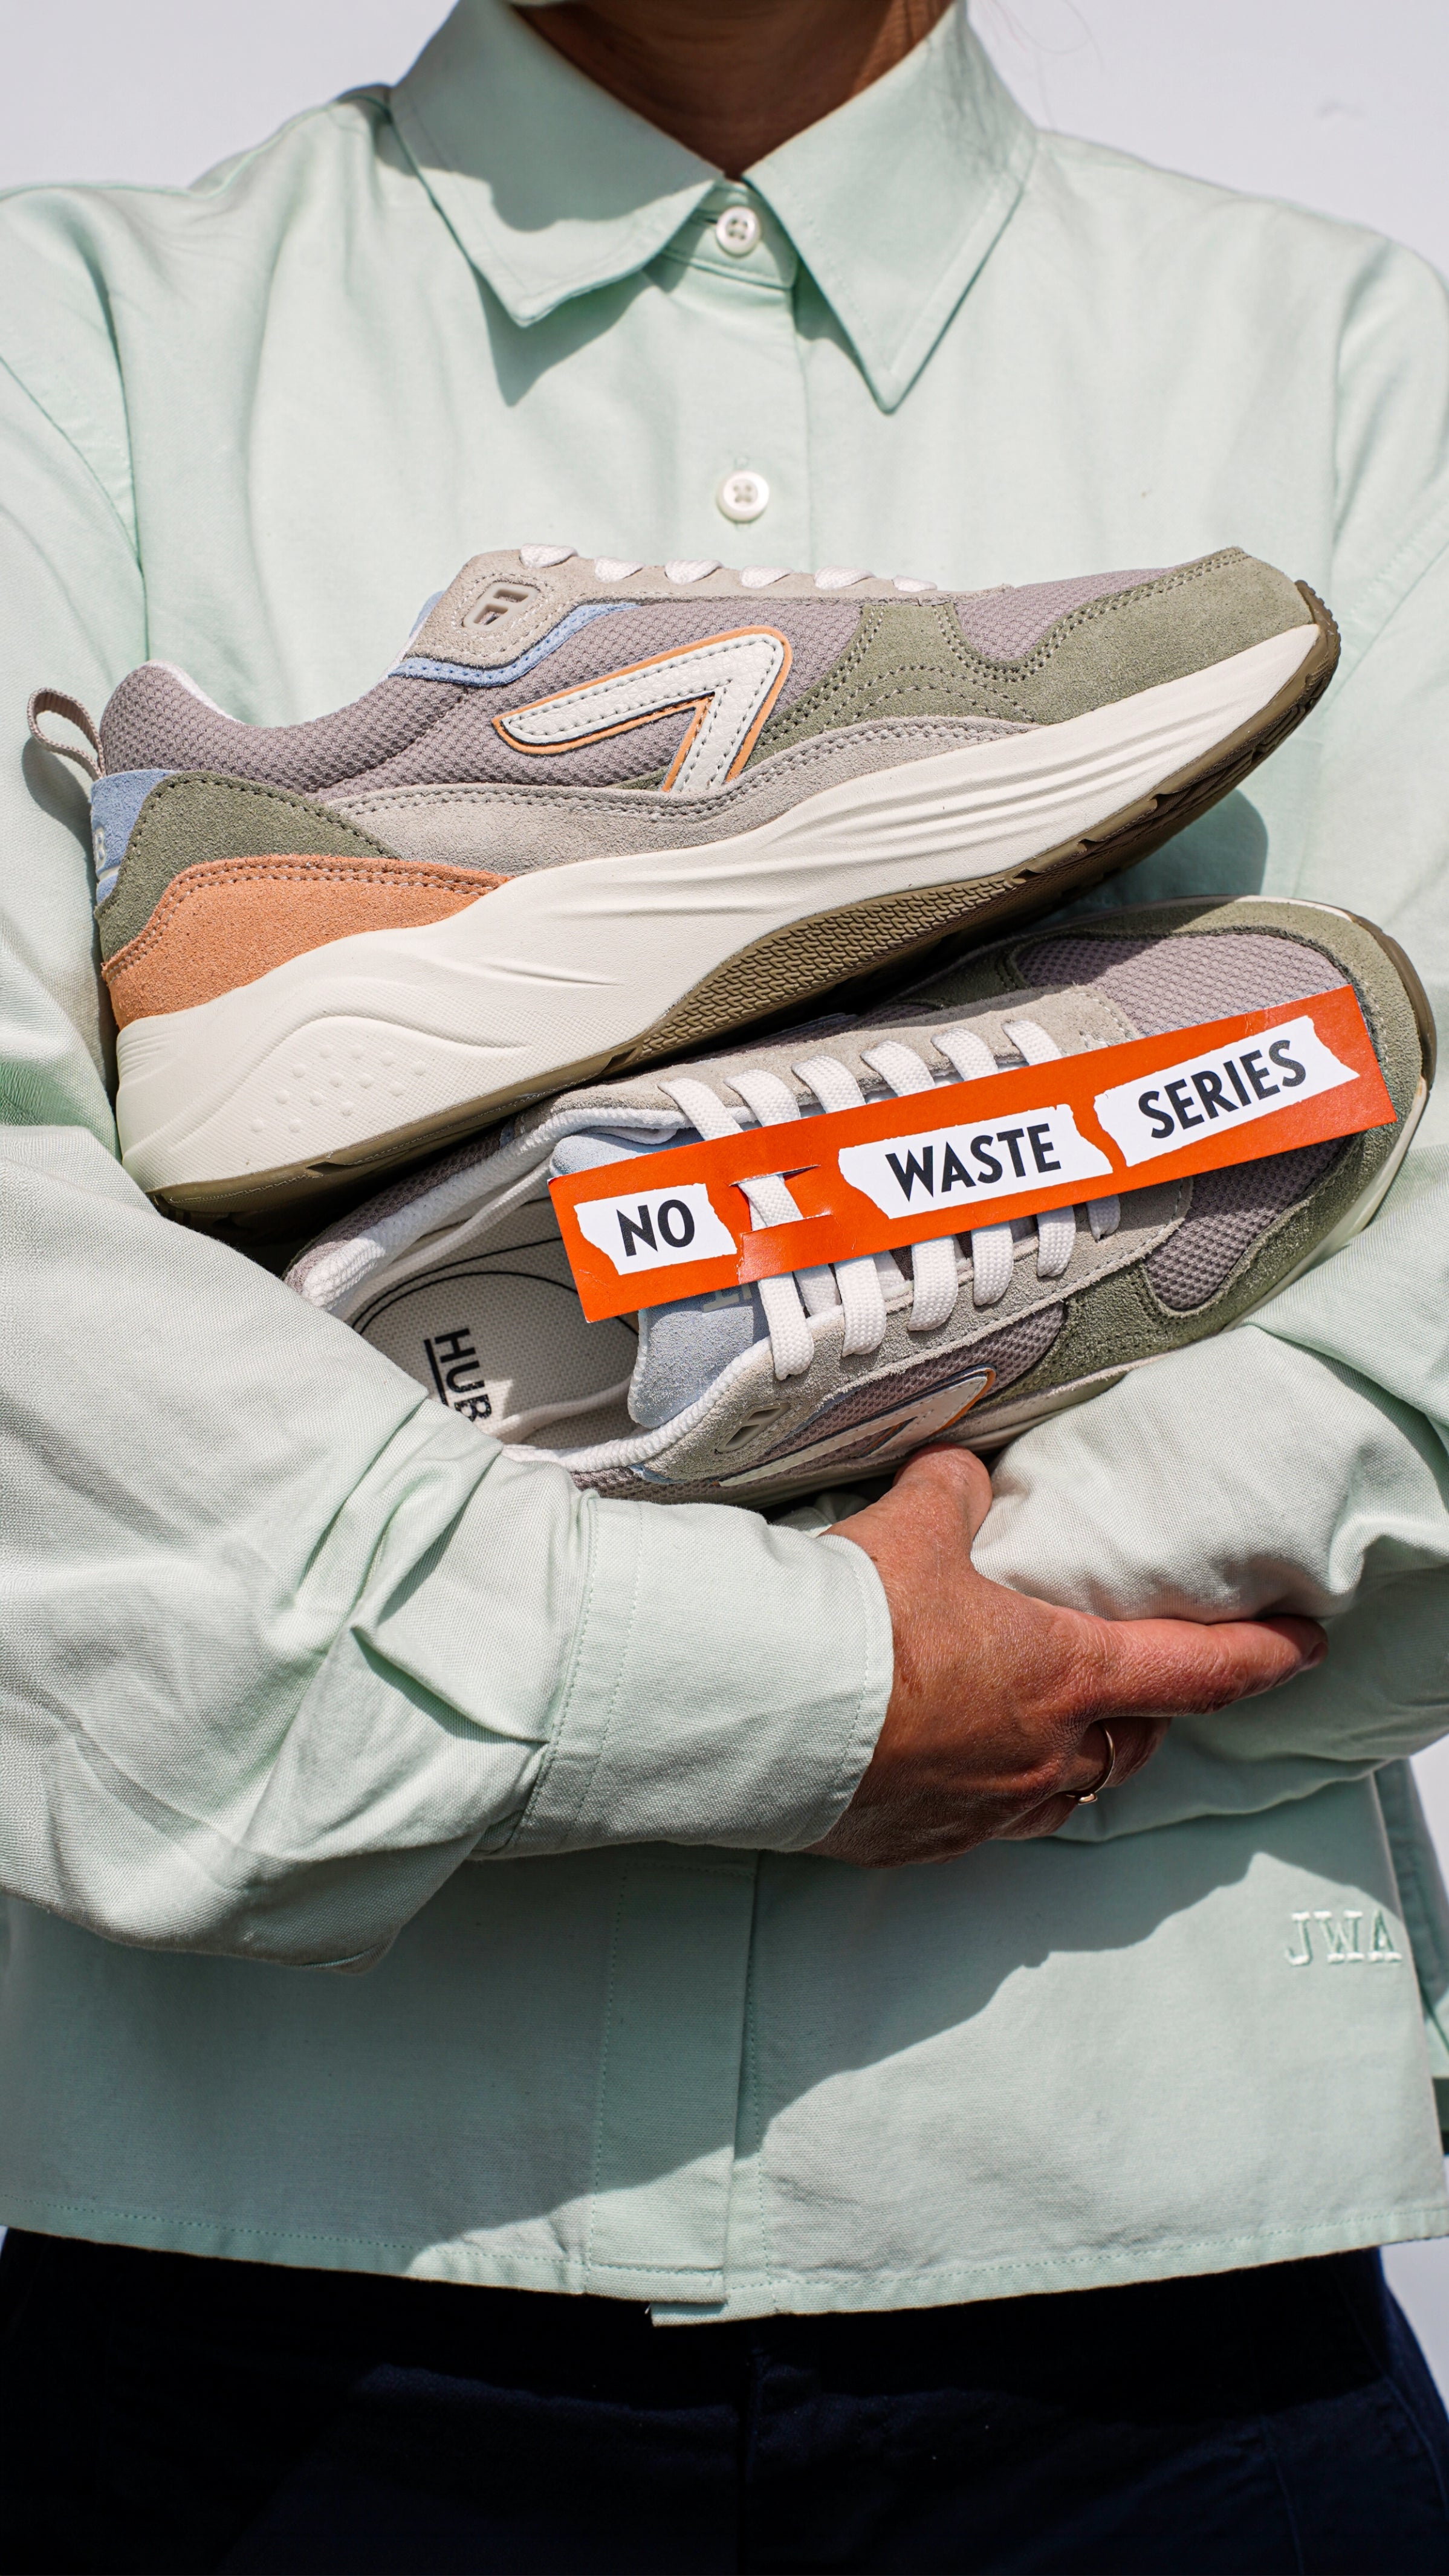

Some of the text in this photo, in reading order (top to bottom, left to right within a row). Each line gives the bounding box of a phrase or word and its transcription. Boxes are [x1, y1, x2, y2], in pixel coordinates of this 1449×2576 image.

[617, 1039, 1307, 1257] NO WASTE SERIES
[433, 1328, 492, 1422] HUB
[1285, 1909, 1402, 1966] JWA
